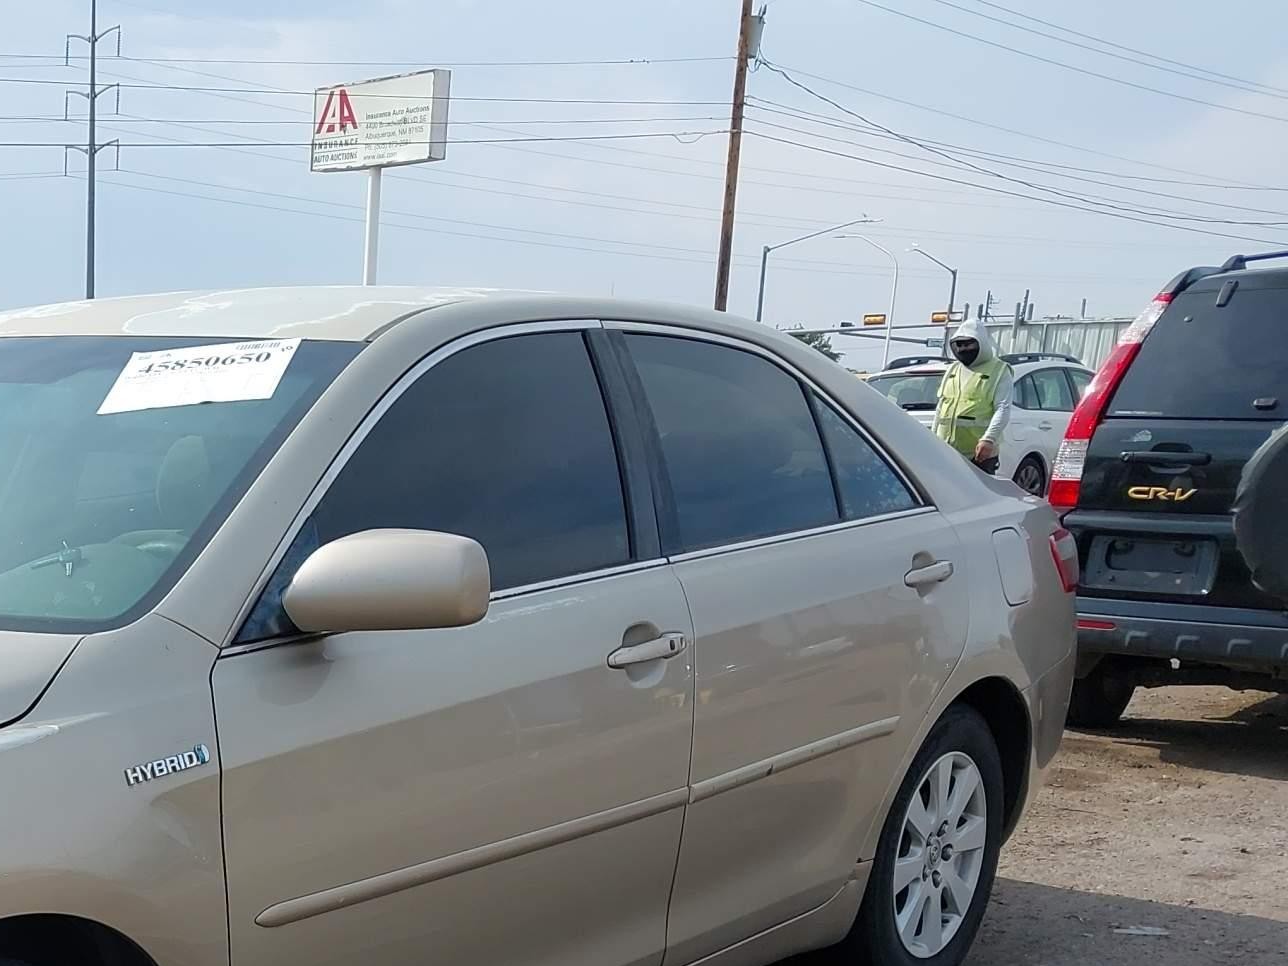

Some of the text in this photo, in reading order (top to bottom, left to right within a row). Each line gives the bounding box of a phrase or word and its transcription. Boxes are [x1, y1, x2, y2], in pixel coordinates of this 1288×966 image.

[405, 105, 430, 114] Auctions
[314, 151, 358, 163] AUTO AUCTIONS
[138, 352, 271, 374] 45850650
[1127, 486, 1198, 501] CR-V
[124, 751, 198, 786] HYBRID
